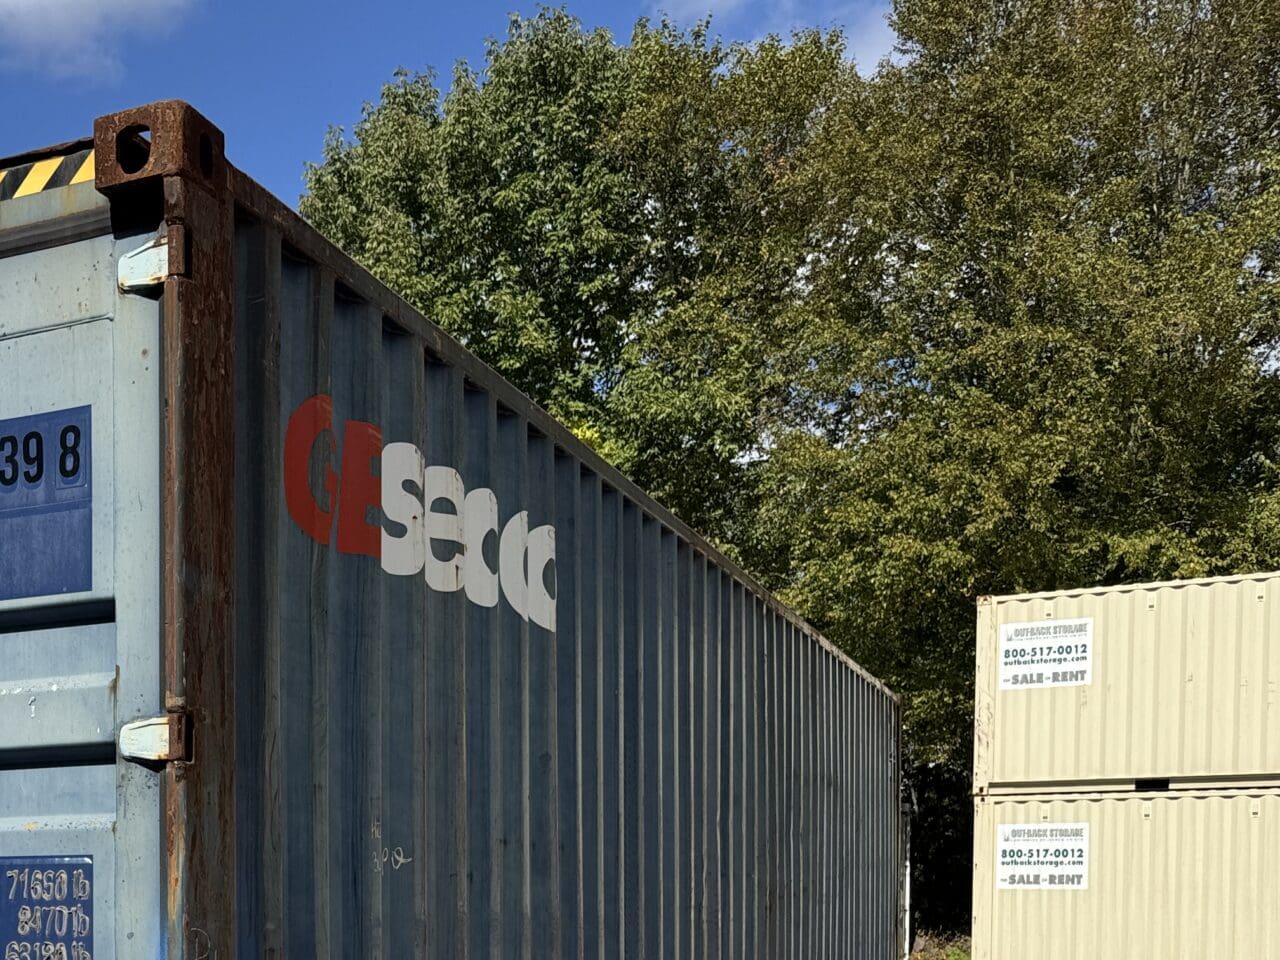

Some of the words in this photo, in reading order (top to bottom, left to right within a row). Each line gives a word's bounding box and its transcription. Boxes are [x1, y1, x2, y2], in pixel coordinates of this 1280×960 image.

[59, 424, 81, 478] 8
[1004, 644, 1087, 659] 800-517-0012
[1011, 672, 1044, 685] SALE
[1052, 670, 1087, 683] RENT
[1001, 848, 1084, 859] 800-517-0012
[6, 868, 68, 901] 71650
[1008, 874, 1041, 885] SALE
[1048, 874, 1083, 885] RENT
